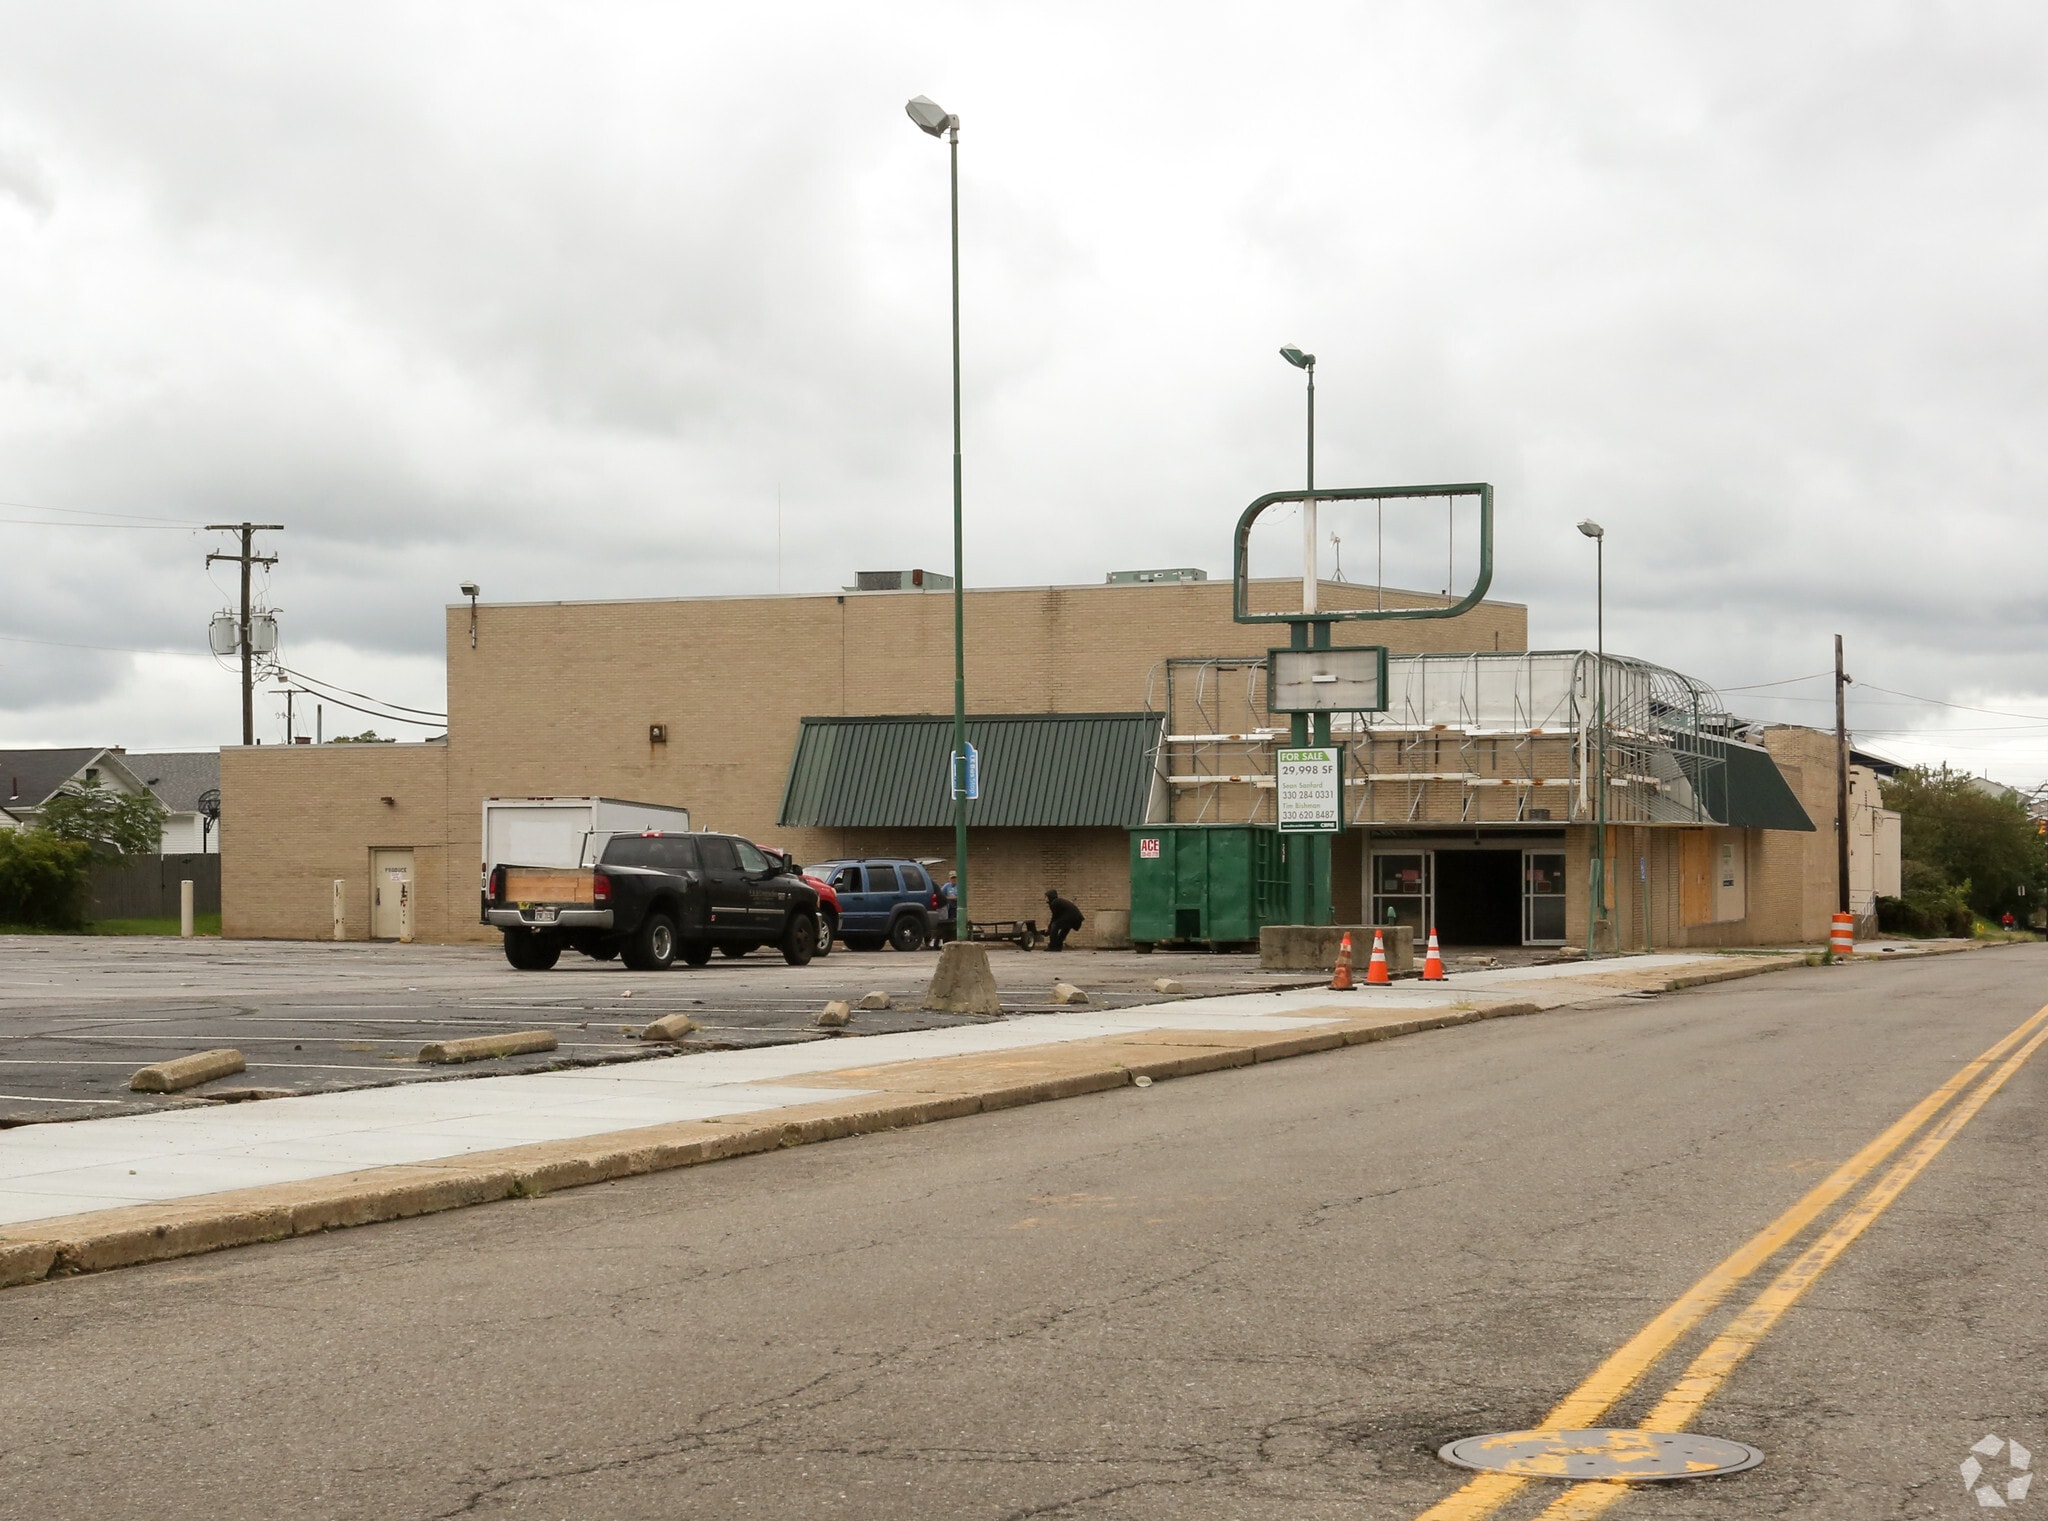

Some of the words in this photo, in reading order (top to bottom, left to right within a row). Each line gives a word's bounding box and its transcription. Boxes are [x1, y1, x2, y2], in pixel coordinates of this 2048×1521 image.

[1281, 752, 1299, 761] FOR
[1302, 752, 1323, 760] SALE
[1282, 765, 1318, 776] 29,998
[1322, 765, 1333, 774] SF
[1282, 791, 1297, 800] 330
[1299, 790, 1313, 799] 284
[1315, 790, 1334, 799] 0331
[1282, 811, 1297, 820] 330
[1299, 811, 1314, 819] 620
[1315, 810, 1335, 819] 8487
[1141, 840, 1158, 851] ACE
